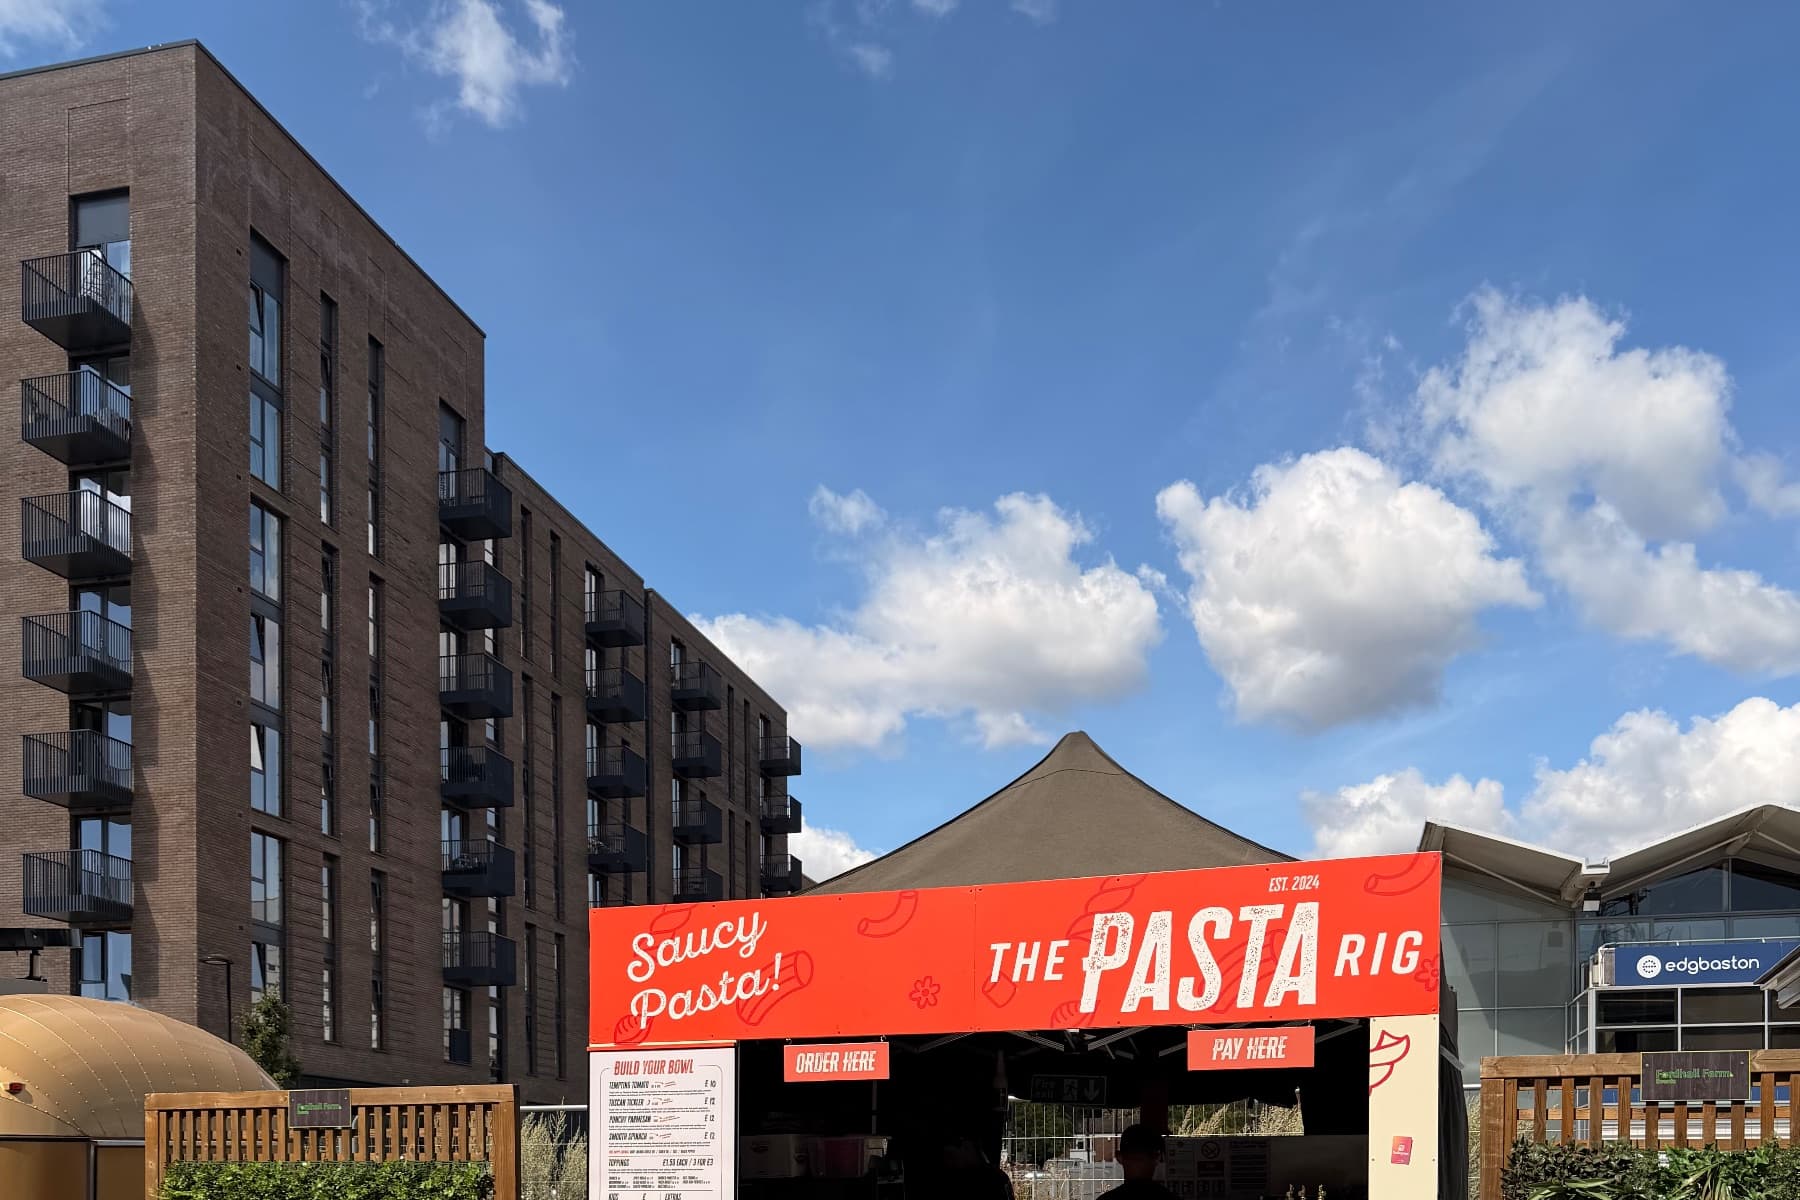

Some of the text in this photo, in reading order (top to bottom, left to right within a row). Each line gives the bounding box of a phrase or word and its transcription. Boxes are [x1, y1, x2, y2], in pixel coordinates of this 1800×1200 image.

[1268, 874, 1320, 893] EST. 2024
[627, 912, 768, 983] Saucy
[988, 901, 1424, 1014] THE PASTA RIG
[1665, 955, 1760, 975] edgbaston
[630, 952, 782, 1030] Pasta!
[1211, 1035, 1288, 1060] PAY HERE
[614, 1058, 694, 1076] BUILD YOUR BOWL
[795, 1050, 877, 1073] ORDER HERE
[608, 1159, 630, 1167] TOPPINGS
